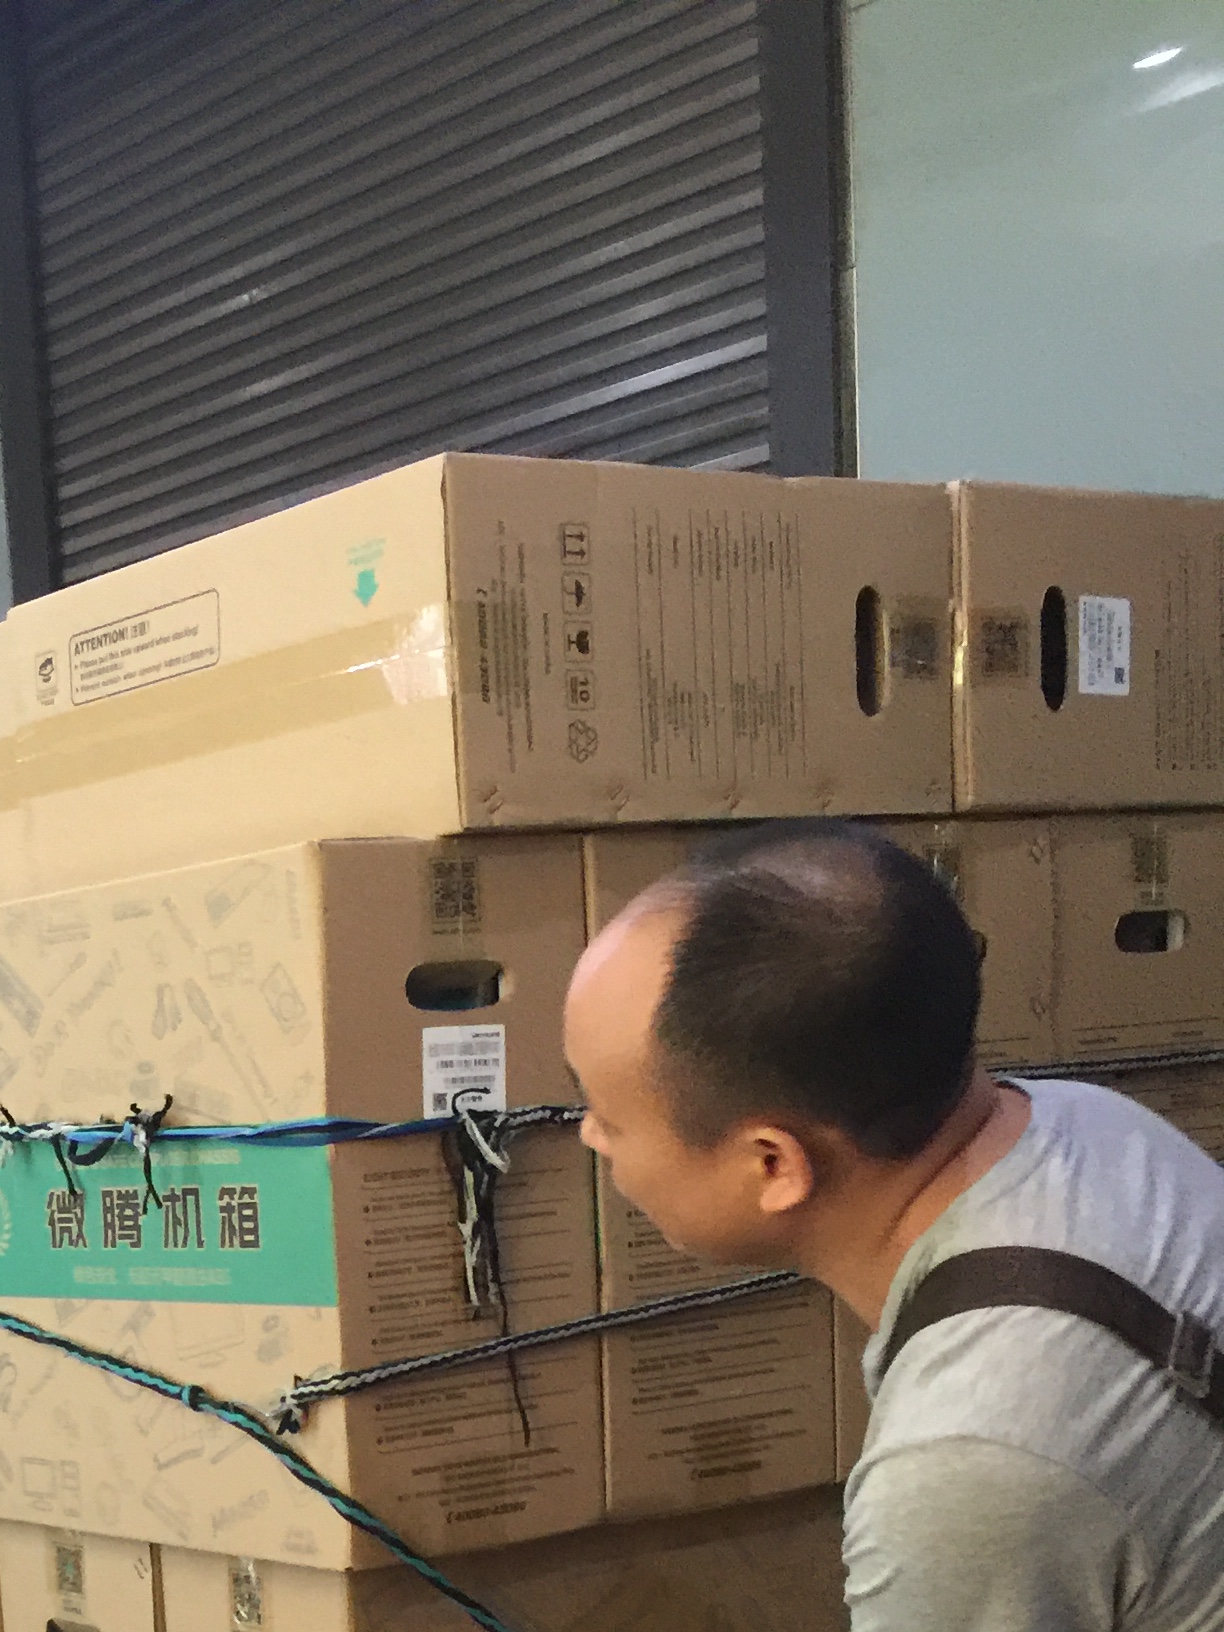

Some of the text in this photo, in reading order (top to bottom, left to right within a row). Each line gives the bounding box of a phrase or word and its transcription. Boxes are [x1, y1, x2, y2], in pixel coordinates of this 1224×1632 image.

[74, 626, 129, 657] ATTENTION!
[46, 1185, 261, 1250] 微腾机箱
